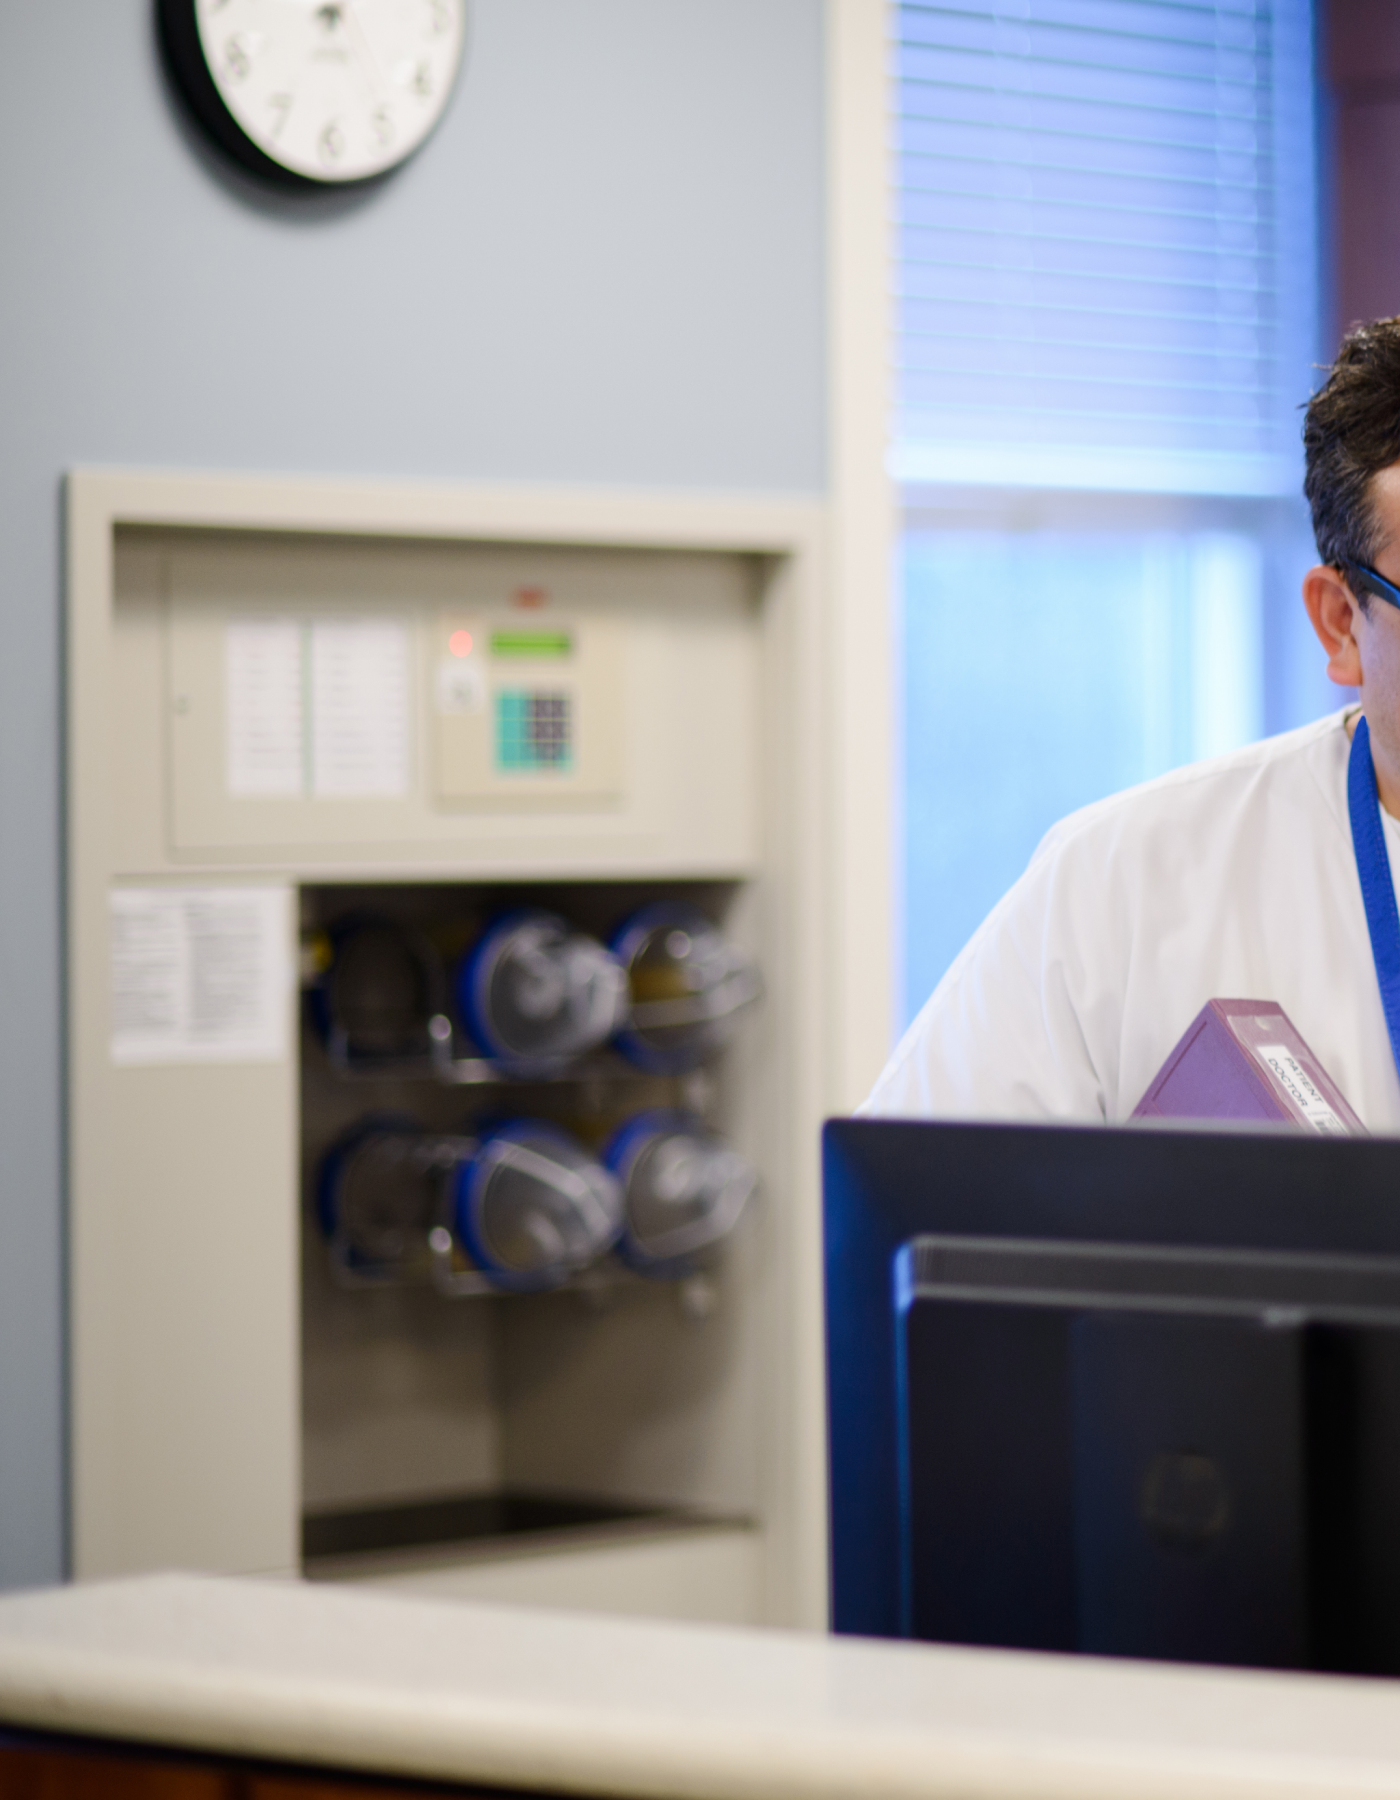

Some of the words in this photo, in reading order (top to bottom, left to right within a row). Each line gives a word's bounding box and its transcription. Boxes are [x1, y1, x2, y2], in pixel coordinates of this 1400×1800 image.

[223, 33, 251, 85] 8
[266, 92, 295, 140] 7
[317, 118, 346, 167] 6
[1268, 1058, 1308, 1106] DOCTOR
[1284, 1058, 1324, 1103] PATIENT
